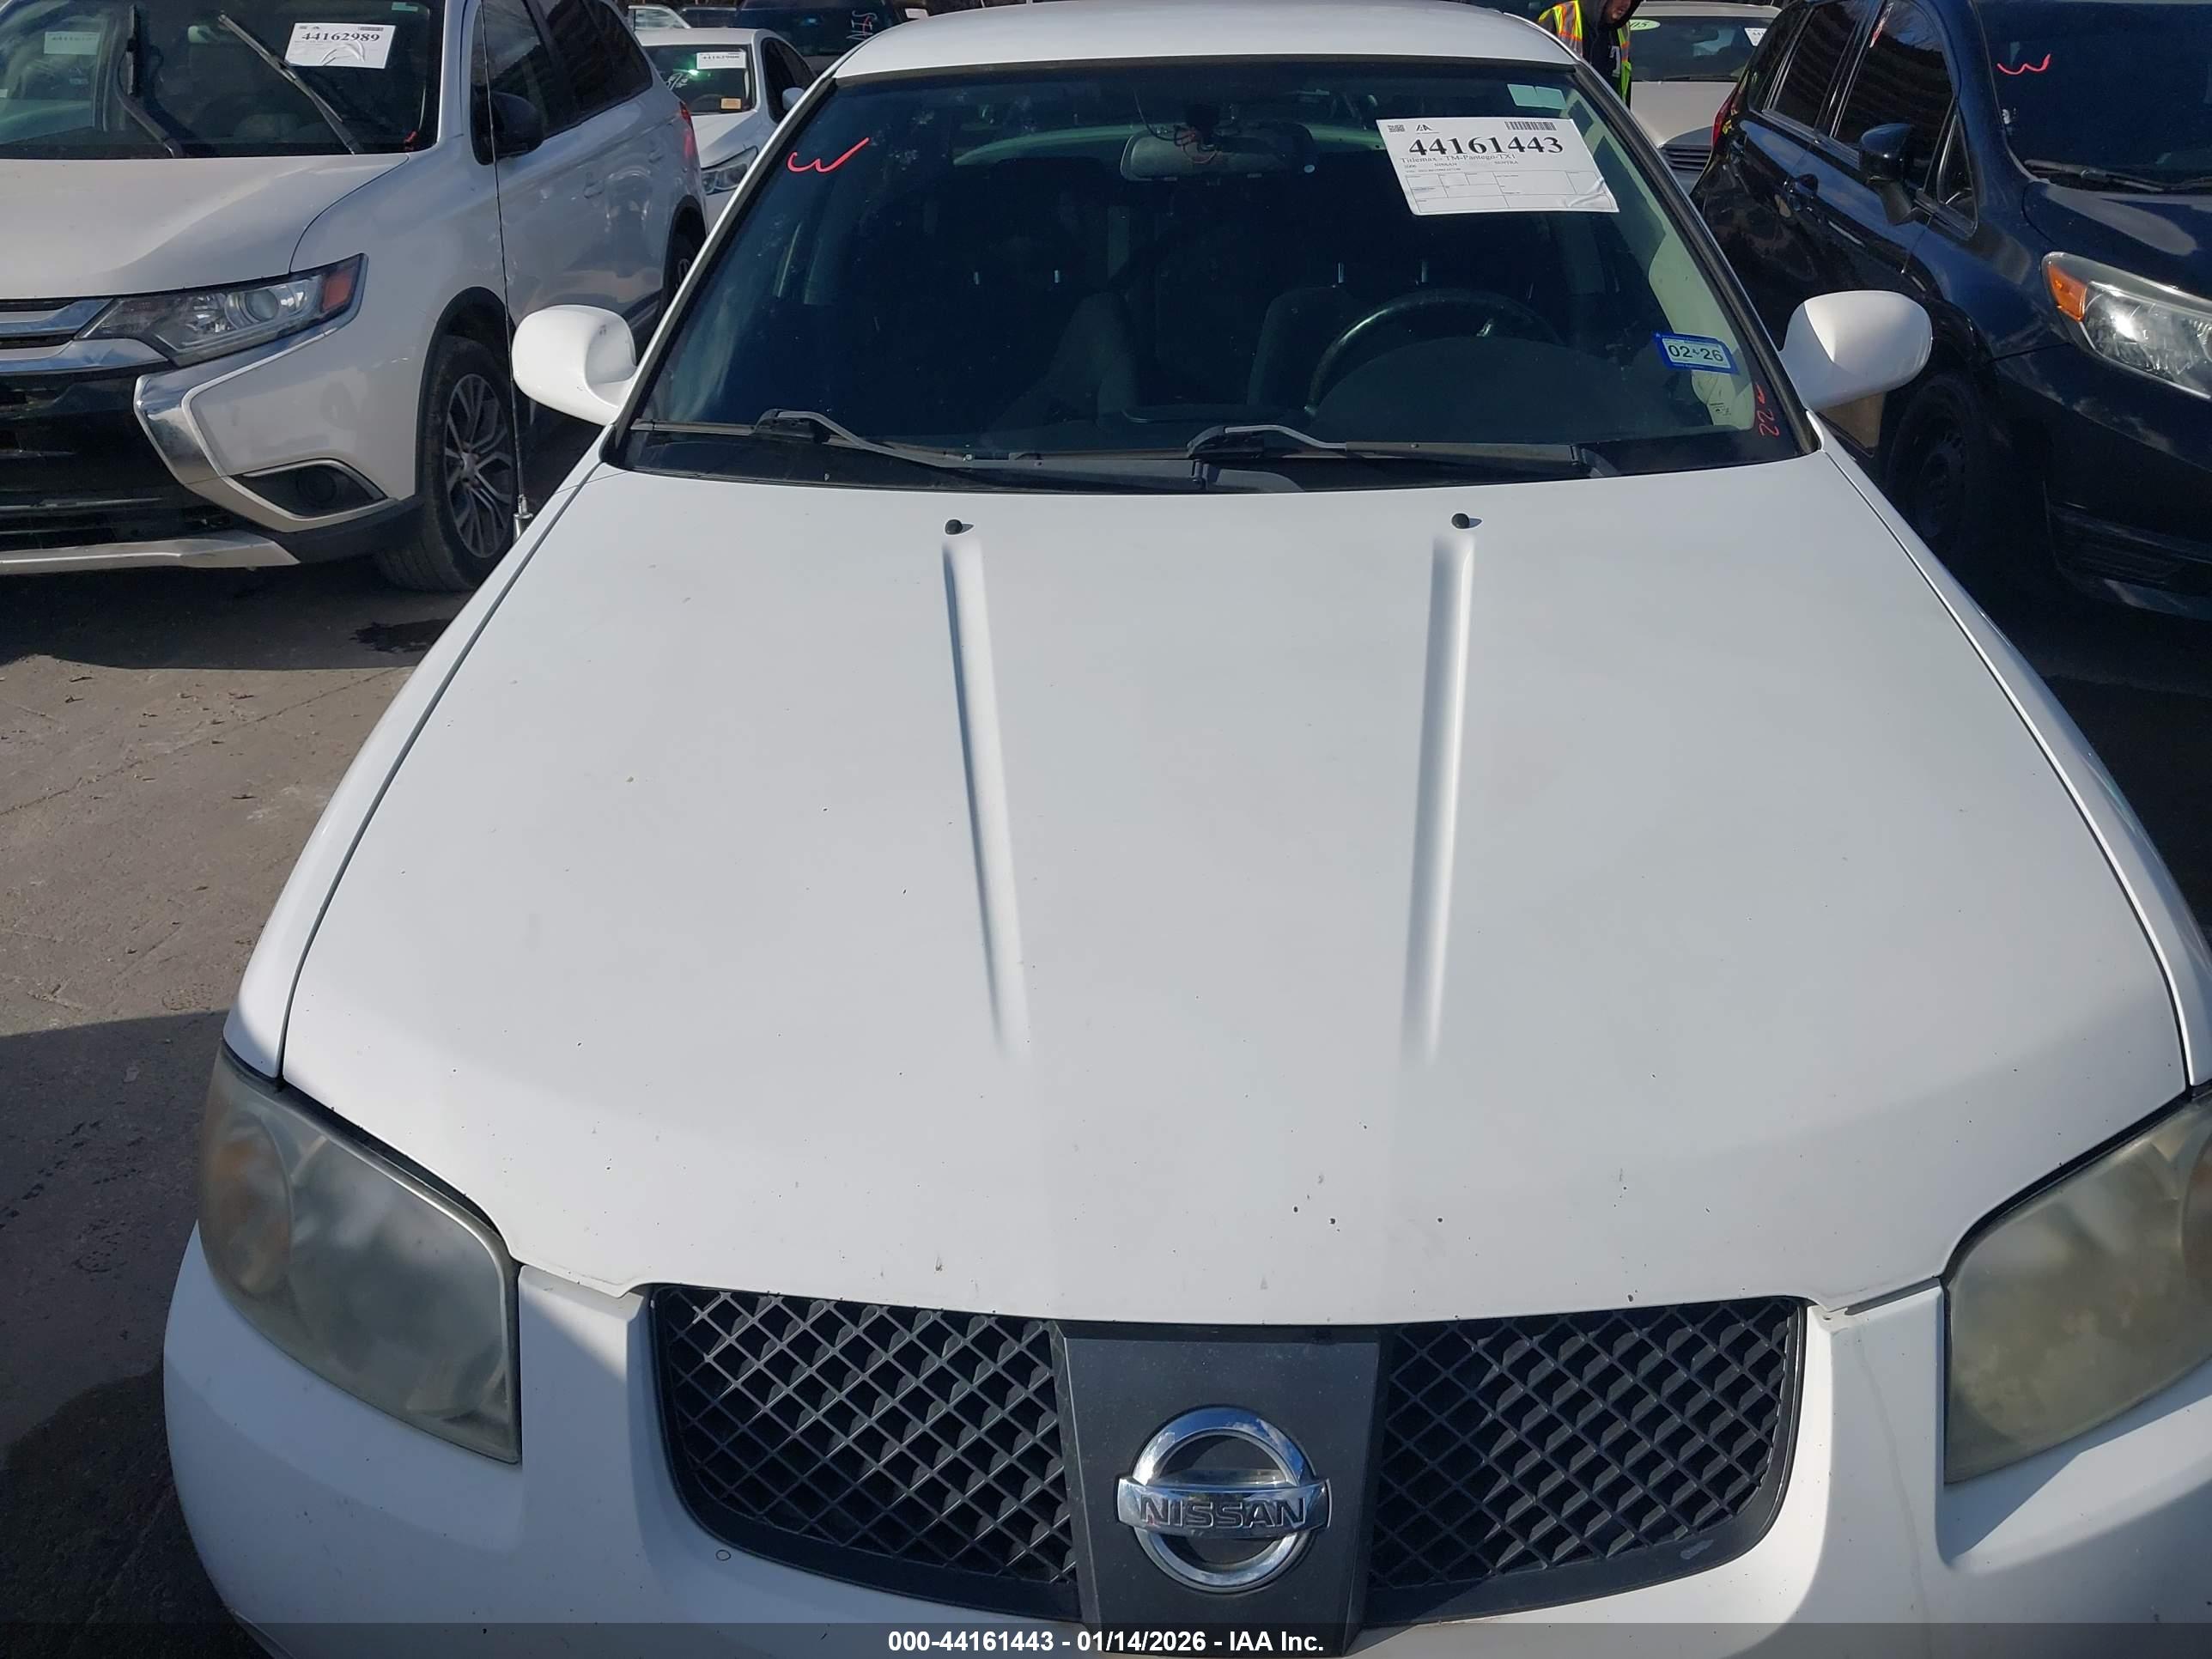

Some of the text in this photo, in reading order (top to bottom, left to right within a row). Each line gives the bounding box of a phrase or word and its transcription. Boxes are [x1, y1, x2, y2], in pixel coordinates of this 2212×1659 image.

[301, 33, 380, 42] 44162989
[1408, 137, 1563, 156] 44161443
[1668, 344, 1724, 362] 02 26
[1140, 1494, 1305, 1528] NISSAN
